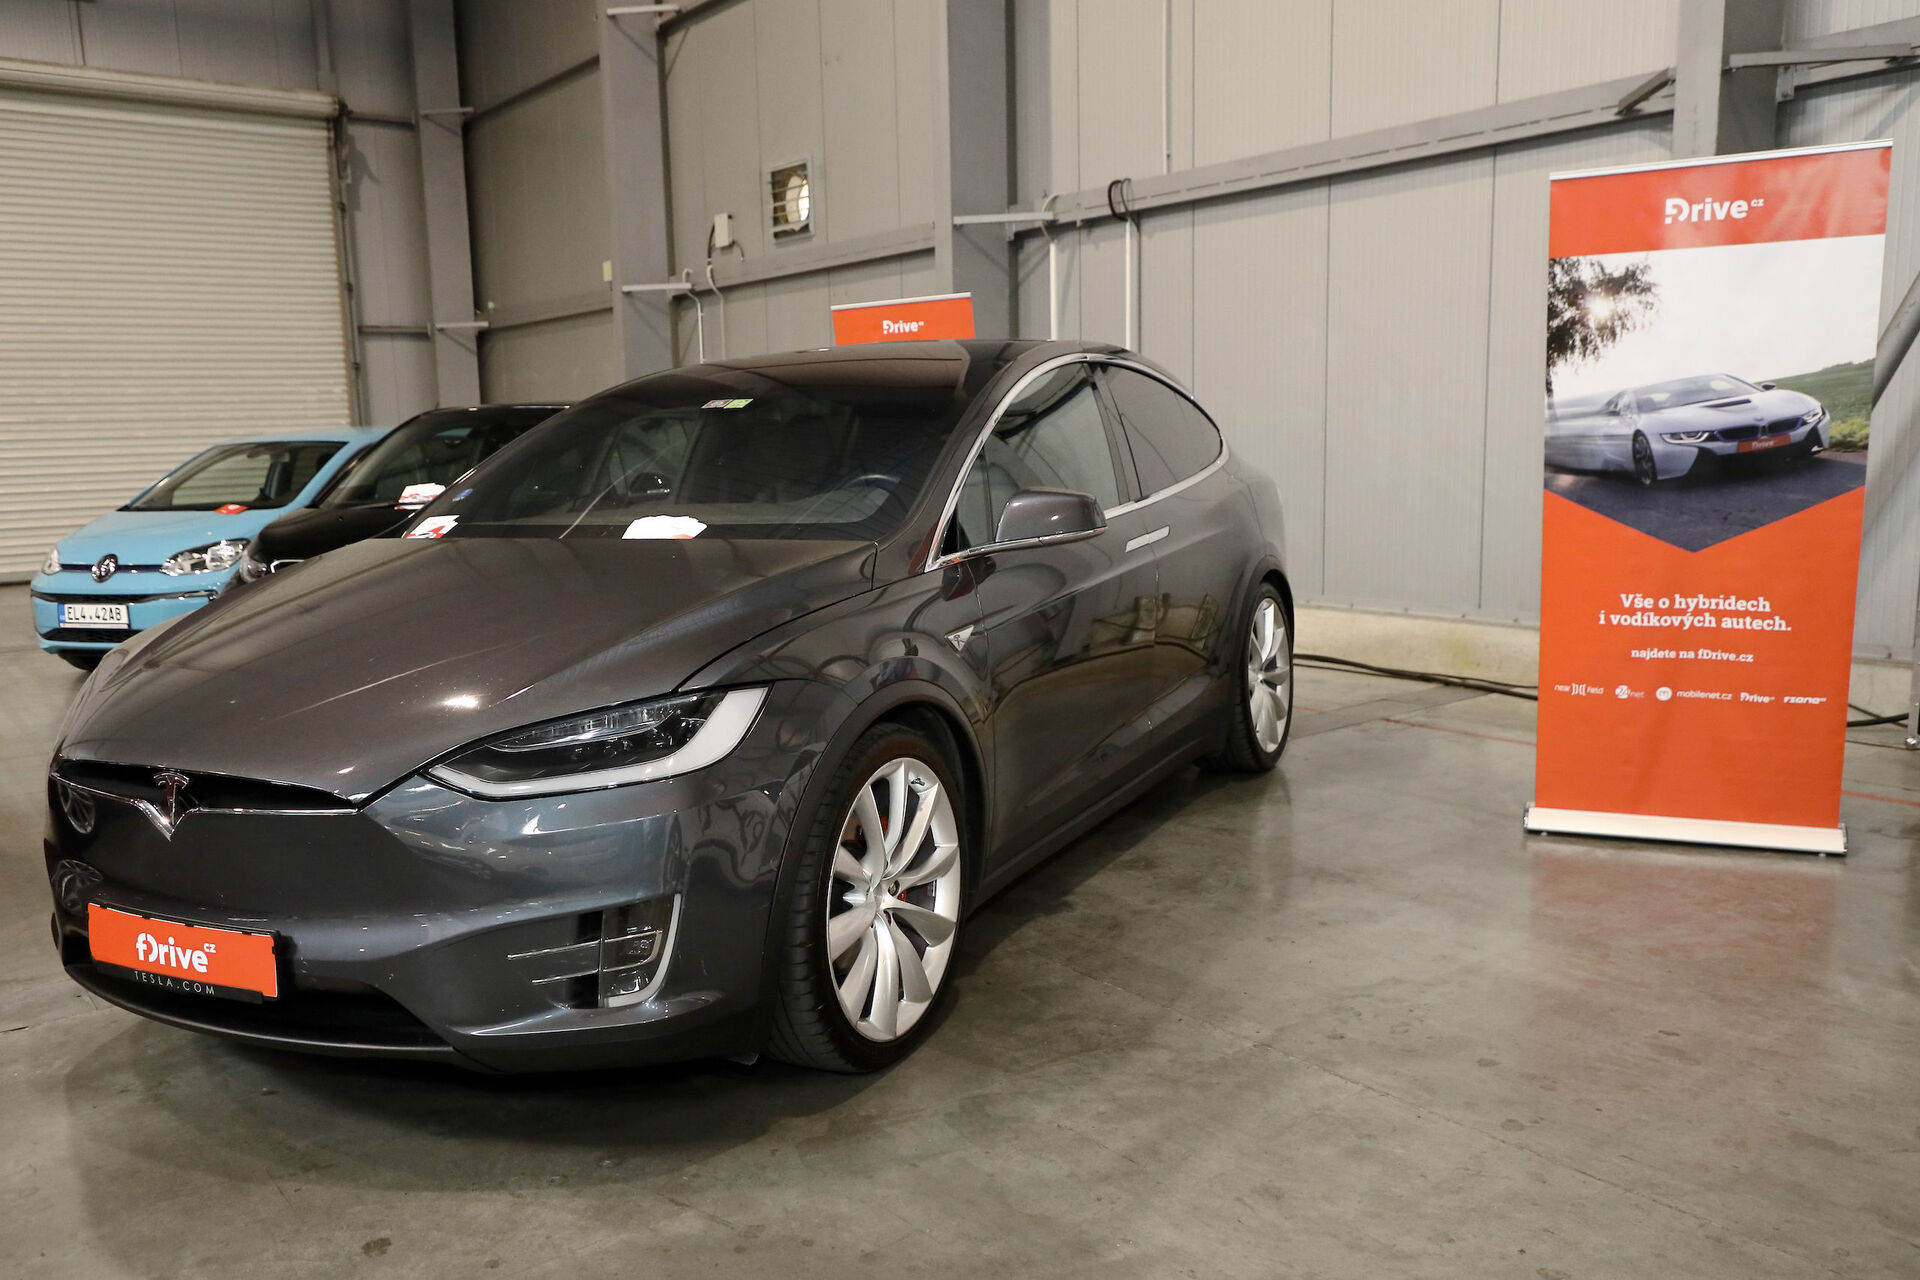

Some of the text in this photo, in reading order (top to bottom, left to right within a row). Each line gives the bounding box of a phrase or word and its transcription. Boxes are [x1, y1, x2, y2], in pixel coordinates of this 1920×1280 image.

[1620, 594, 1771, 612] Vše o hybridech
[1599, 610, 1792, 631] i vodíkových autech.
[1631, 648, 1754, 662] najdete na fDrive.cz
[1676, 690, 1732, 700] mobilenet.cz
[134, 971, 215, 995] TESLA.COM
